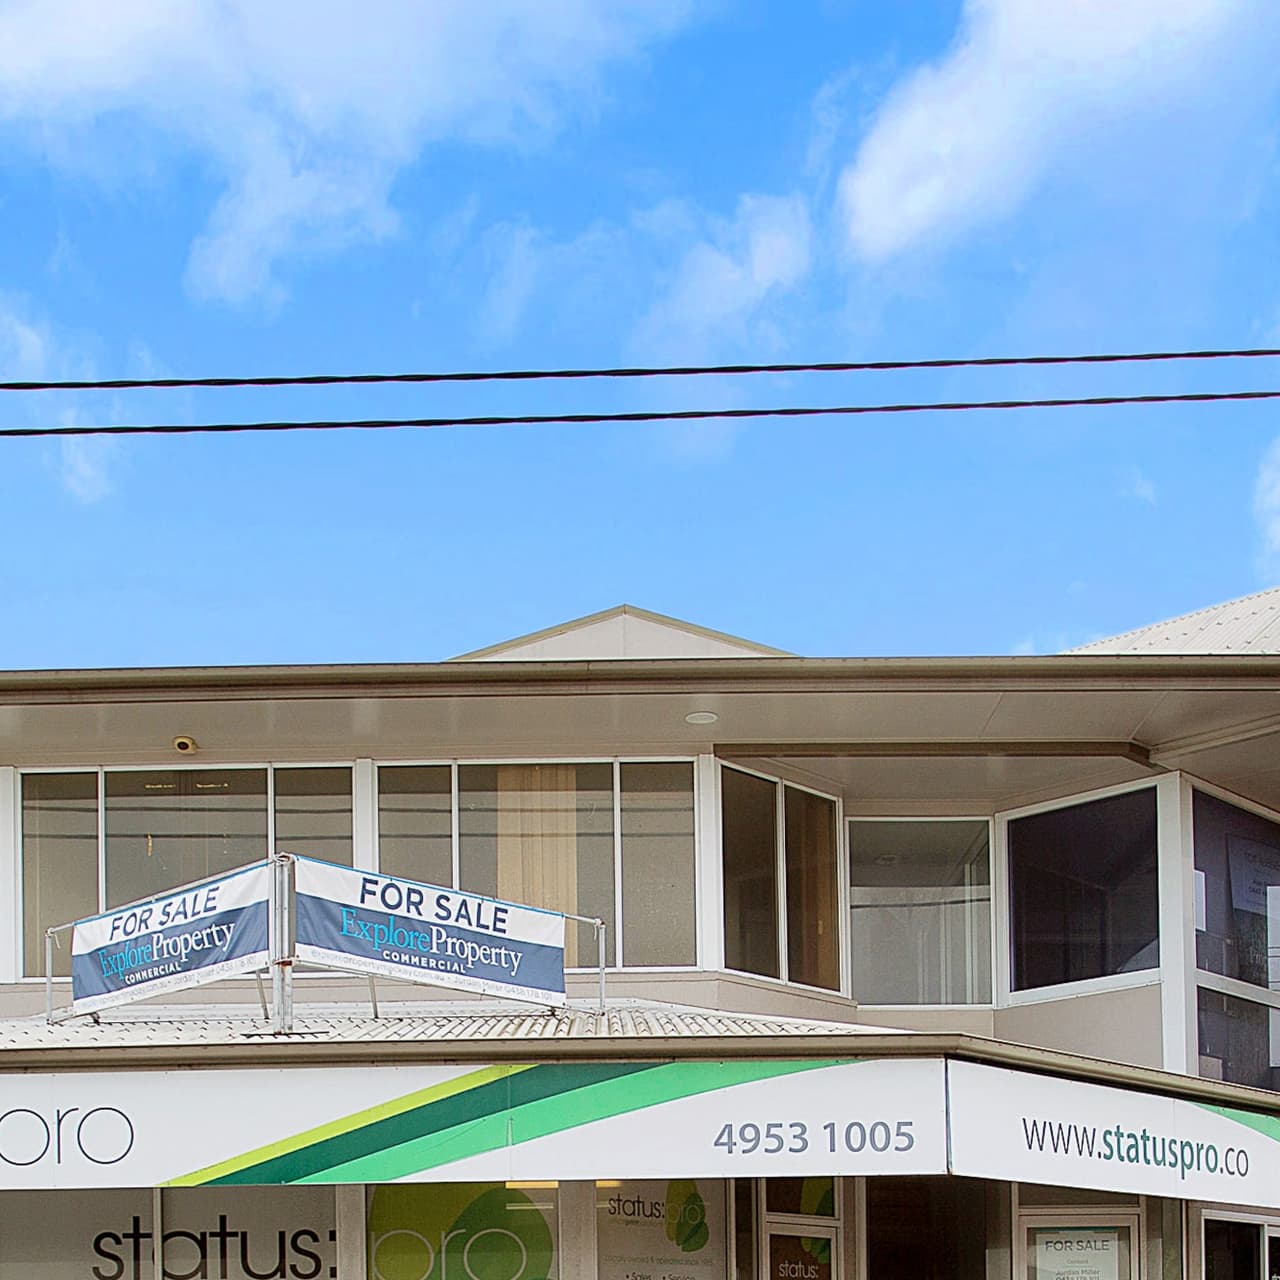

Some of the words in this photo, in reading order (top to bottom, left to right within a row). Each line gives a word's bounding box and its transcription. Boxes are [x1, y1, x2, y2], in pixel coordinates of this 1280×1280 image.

[110, 907, 153, 941] FOR
[158, 886, 219, 926] SALE
[360, 877, 424, 917] FOR
[434, 894, 509, 934] SALE
[125, 961, 182, 985] COMMERCIAL
[383, 950, 467, 974] COMMERCIAL
[714, 1122, 808, 1153] 4953
[823, 1121, 914, 1152] 1005
[1022, 1117, 1249, 1180] www.statuspro.co
[1045, 1240, 1073, 1252] FOR
[1076, 1240, 1110, 1251] SALE
